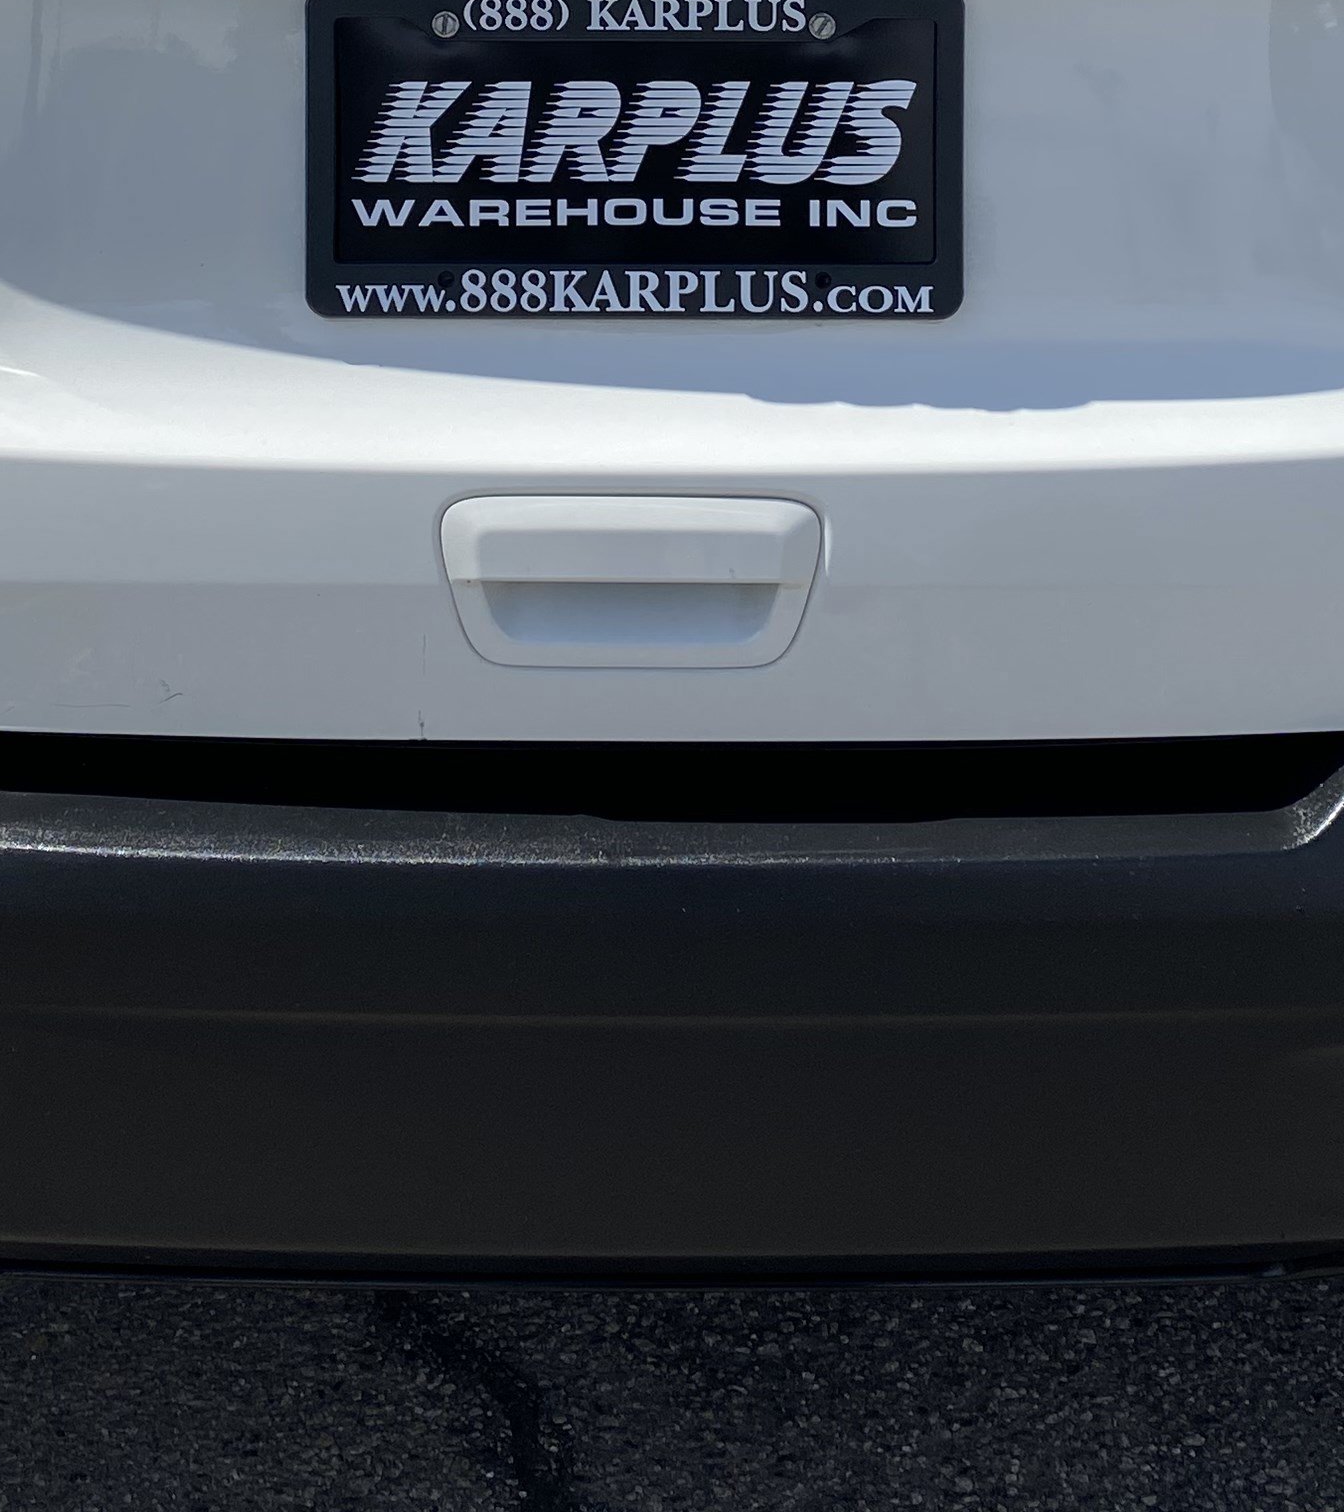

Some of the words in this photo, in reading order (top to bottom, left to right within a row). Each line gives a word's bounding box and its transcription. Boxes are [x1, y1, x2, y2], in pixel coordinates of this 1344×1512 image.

[352, 79, 918, 186] KARPLUS
[352, 198, 782, 228] WAREHOUSE
[809, 198, 919, 228] INC
